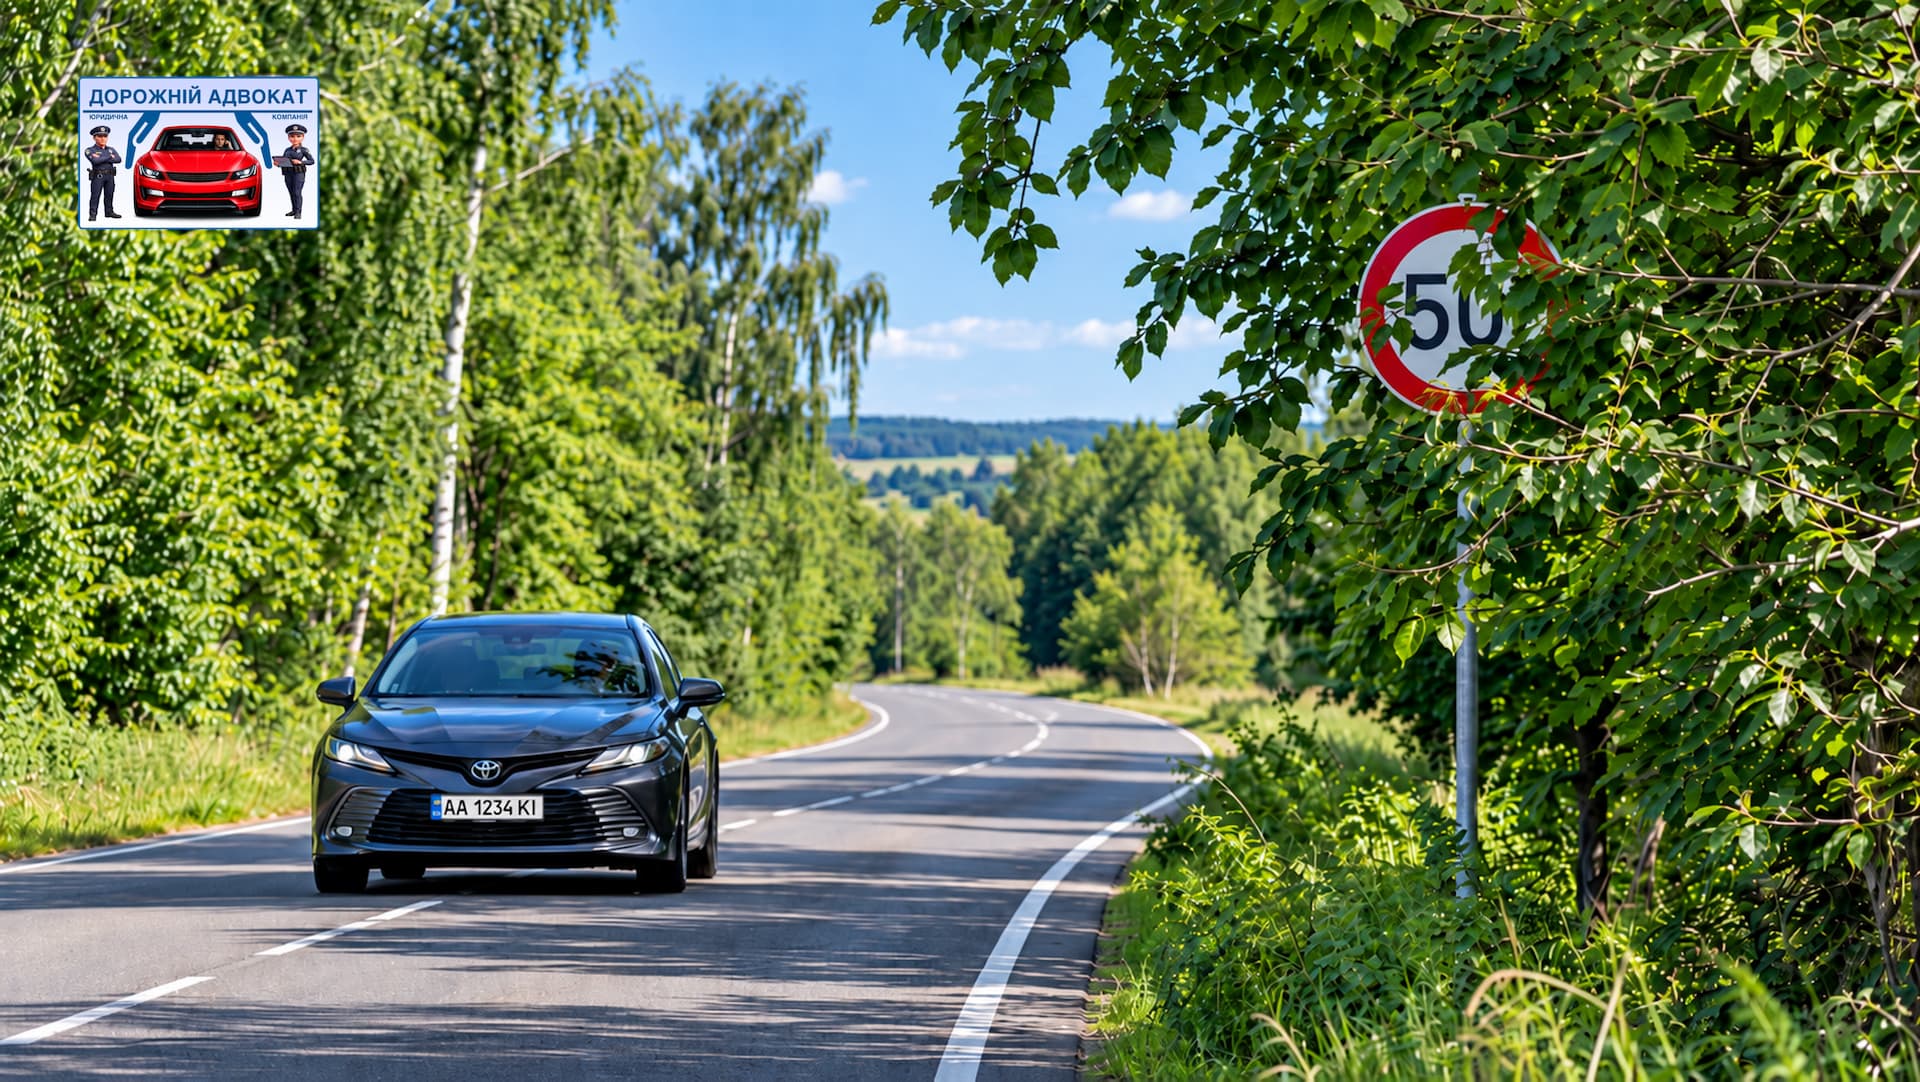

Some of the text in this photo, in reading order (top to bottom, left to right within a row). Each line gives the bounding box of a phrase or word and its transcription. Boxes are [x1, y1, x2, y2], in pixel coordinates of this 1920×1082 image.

[1404, 273, 1503, 350] 50
[444, 799, 536, 815] AA 1234 KI
